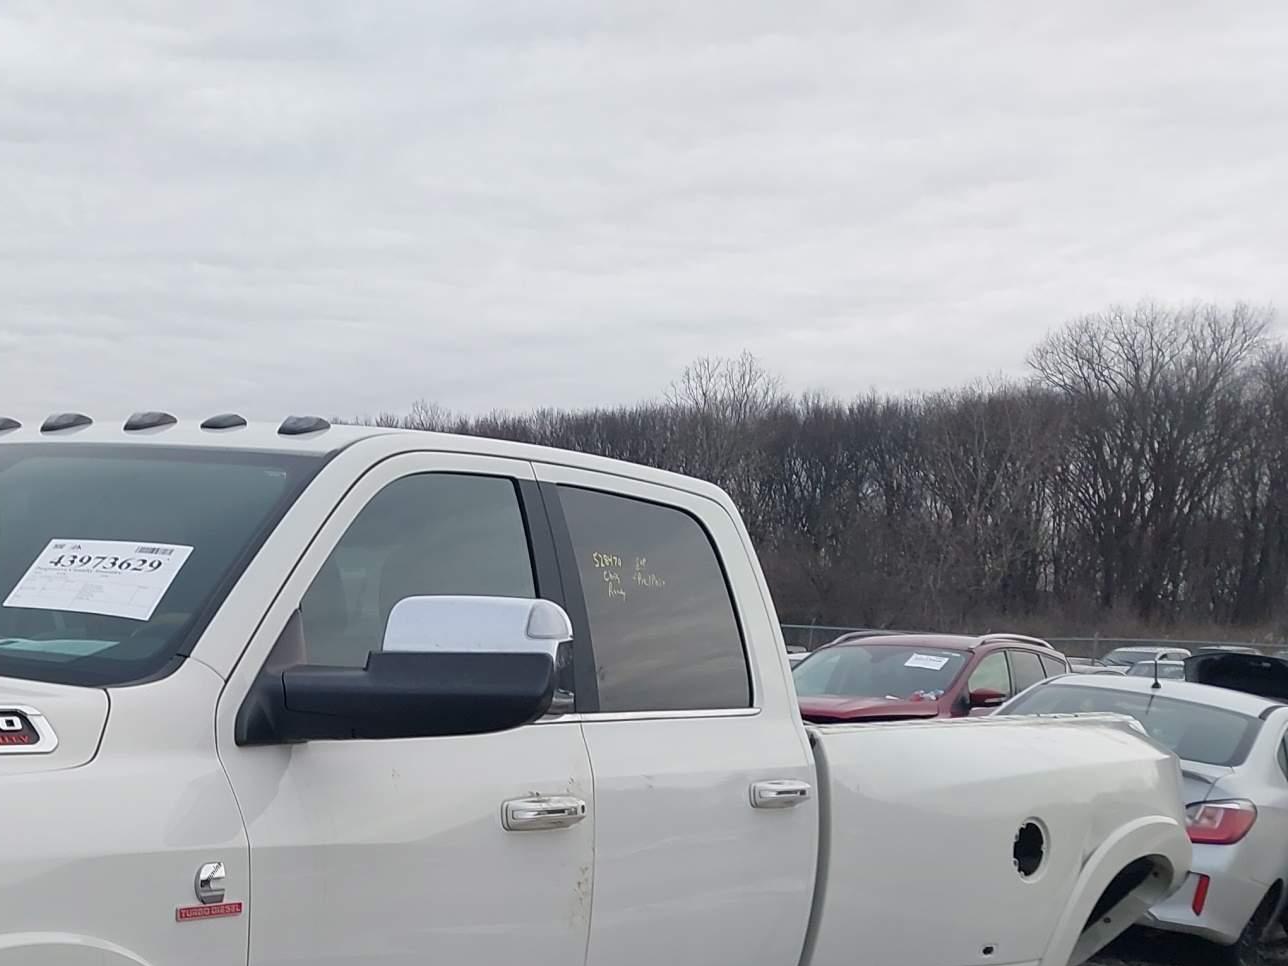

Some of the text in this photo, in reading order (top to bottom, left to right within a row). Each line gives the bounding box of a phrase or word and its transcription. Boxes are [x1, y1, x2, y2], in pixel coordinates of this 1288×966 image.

[49, 554, 163, 573] 43973629
[180, 904, 241, 918] TURBO DIESEL
